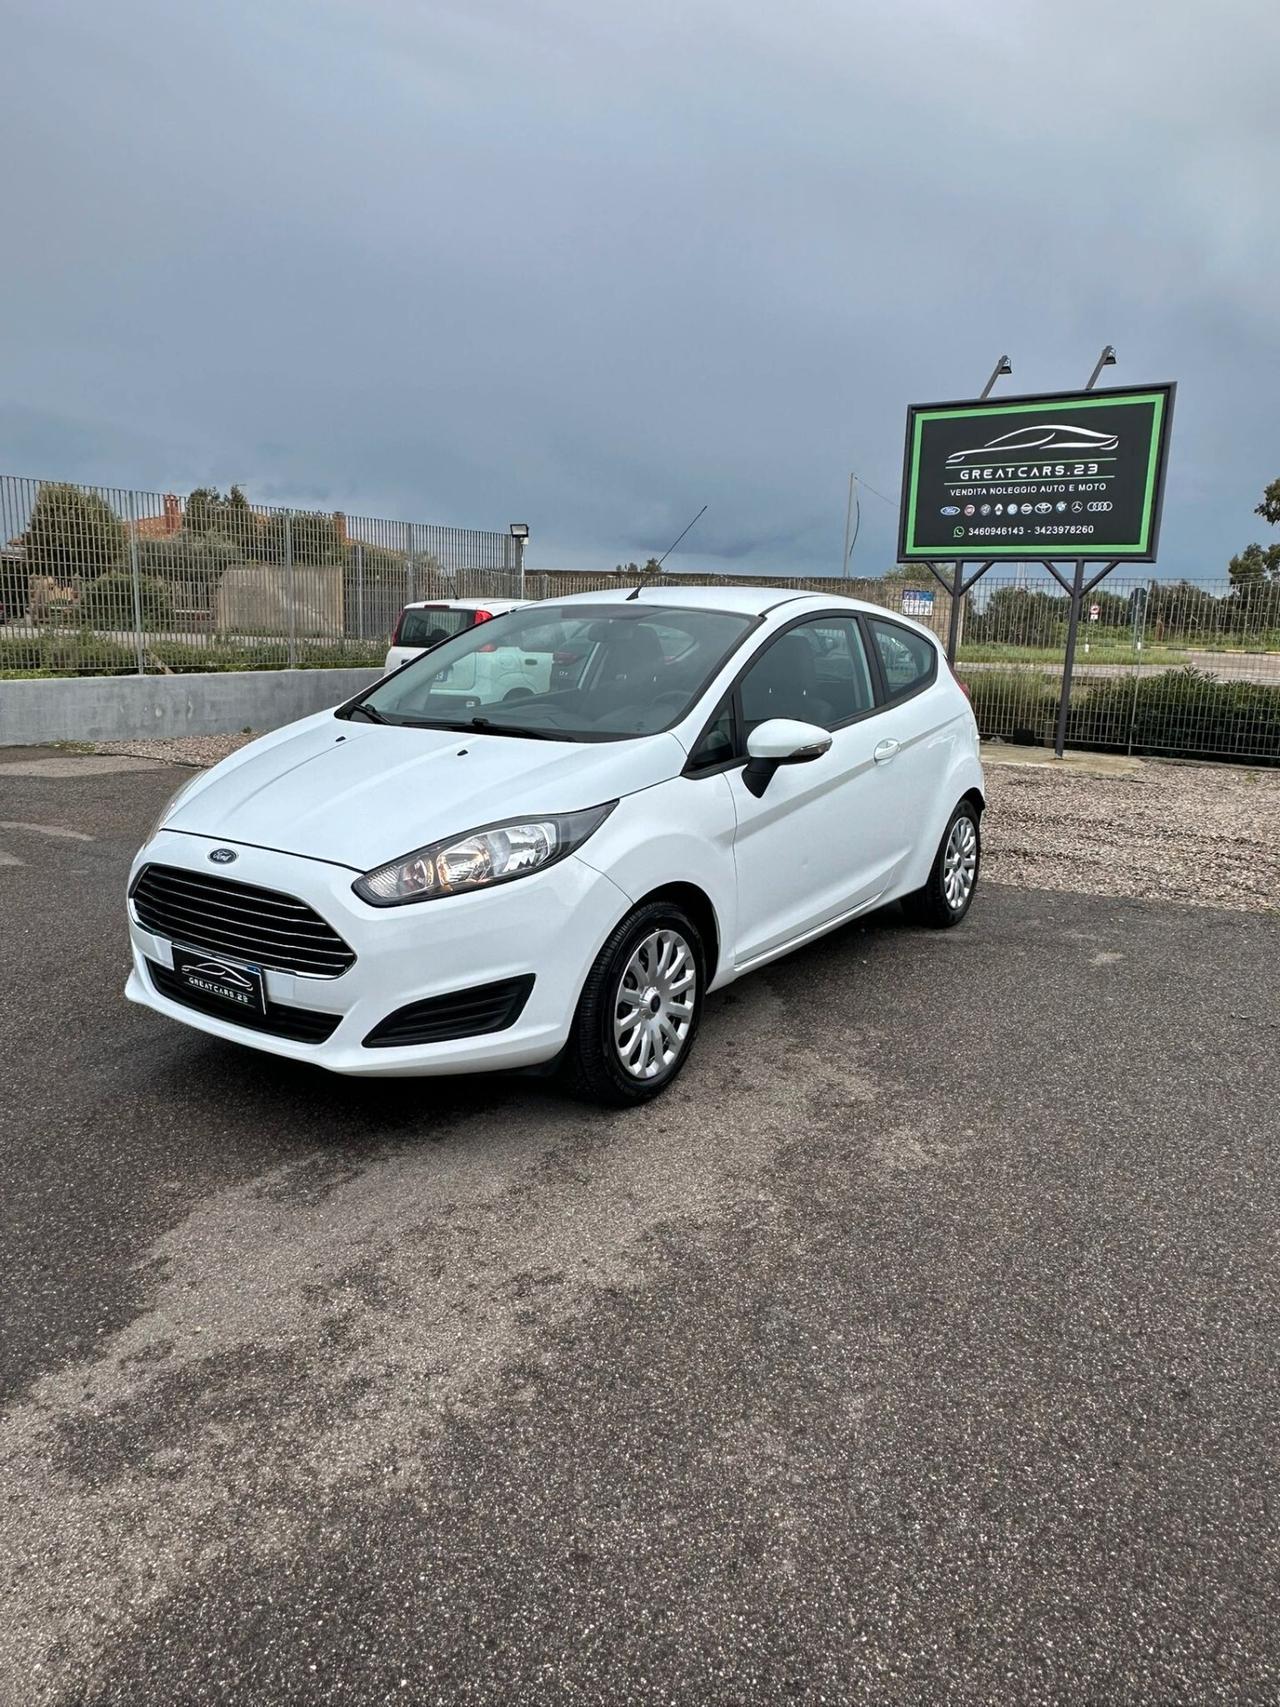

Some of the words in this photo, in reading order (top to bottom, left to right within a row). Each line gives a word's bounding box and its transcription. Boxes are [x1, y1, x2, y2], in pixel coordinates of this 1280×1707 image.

[960, 463, 1098, 480] GREATCARS.23
[950, 487, 987, 496] VENDITA
[990, 485, 1037, 495] NOLEGGIO
[1040, 484, 1065, 493] AUTO
[1069, 484, 1075, 492] E
[1078, 482, 1107, 491] MOTO
[968, 526, 1024, 536] 3460946143
[1034, 525, 1094, 535] 3423978260
